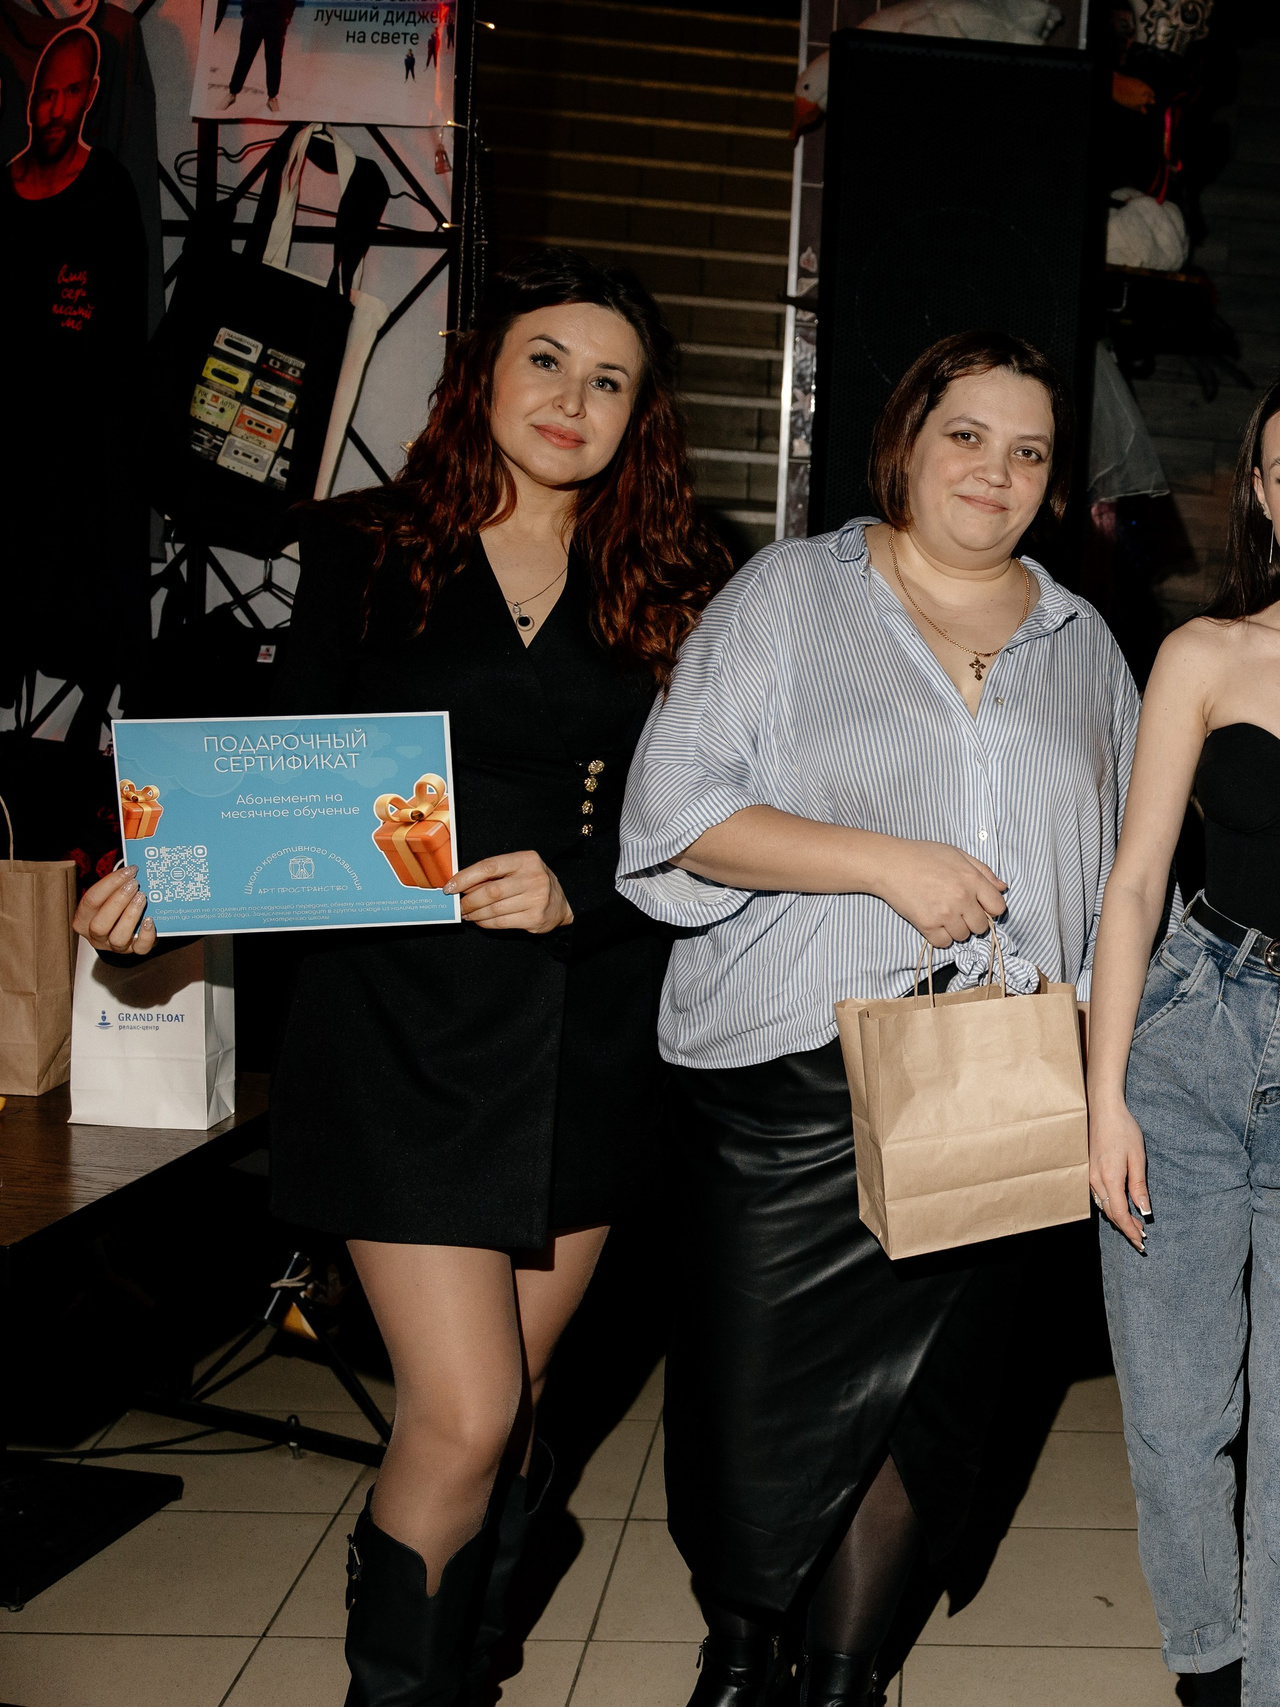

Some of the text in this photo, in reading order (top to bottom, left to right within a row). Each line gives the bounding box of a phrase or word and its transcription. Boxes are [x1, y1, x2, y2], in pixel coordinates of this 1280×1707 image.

[314, 6, 448, 26] лучший диджей
[345, 30, 420, 46] на свете
[203, 728, 368, 755] ПОДАРОЧНЫЙ
[213, 753, 361, 773] СЕРТИФИКАТ
[236, 794, 344, 806] Абонемент на
[221, 805, 361, 819] месячное обучение
[244, 845, 364, 895] Школа креативного развития
[258, 885, 349, 895] АРТ ПРОСТРАНСТВО
[155, 907, 201, 915] Сертификат
[212, 906, 247, 914] подлежит
[117, 1012, 185, 1023] GRAND FLOAT
